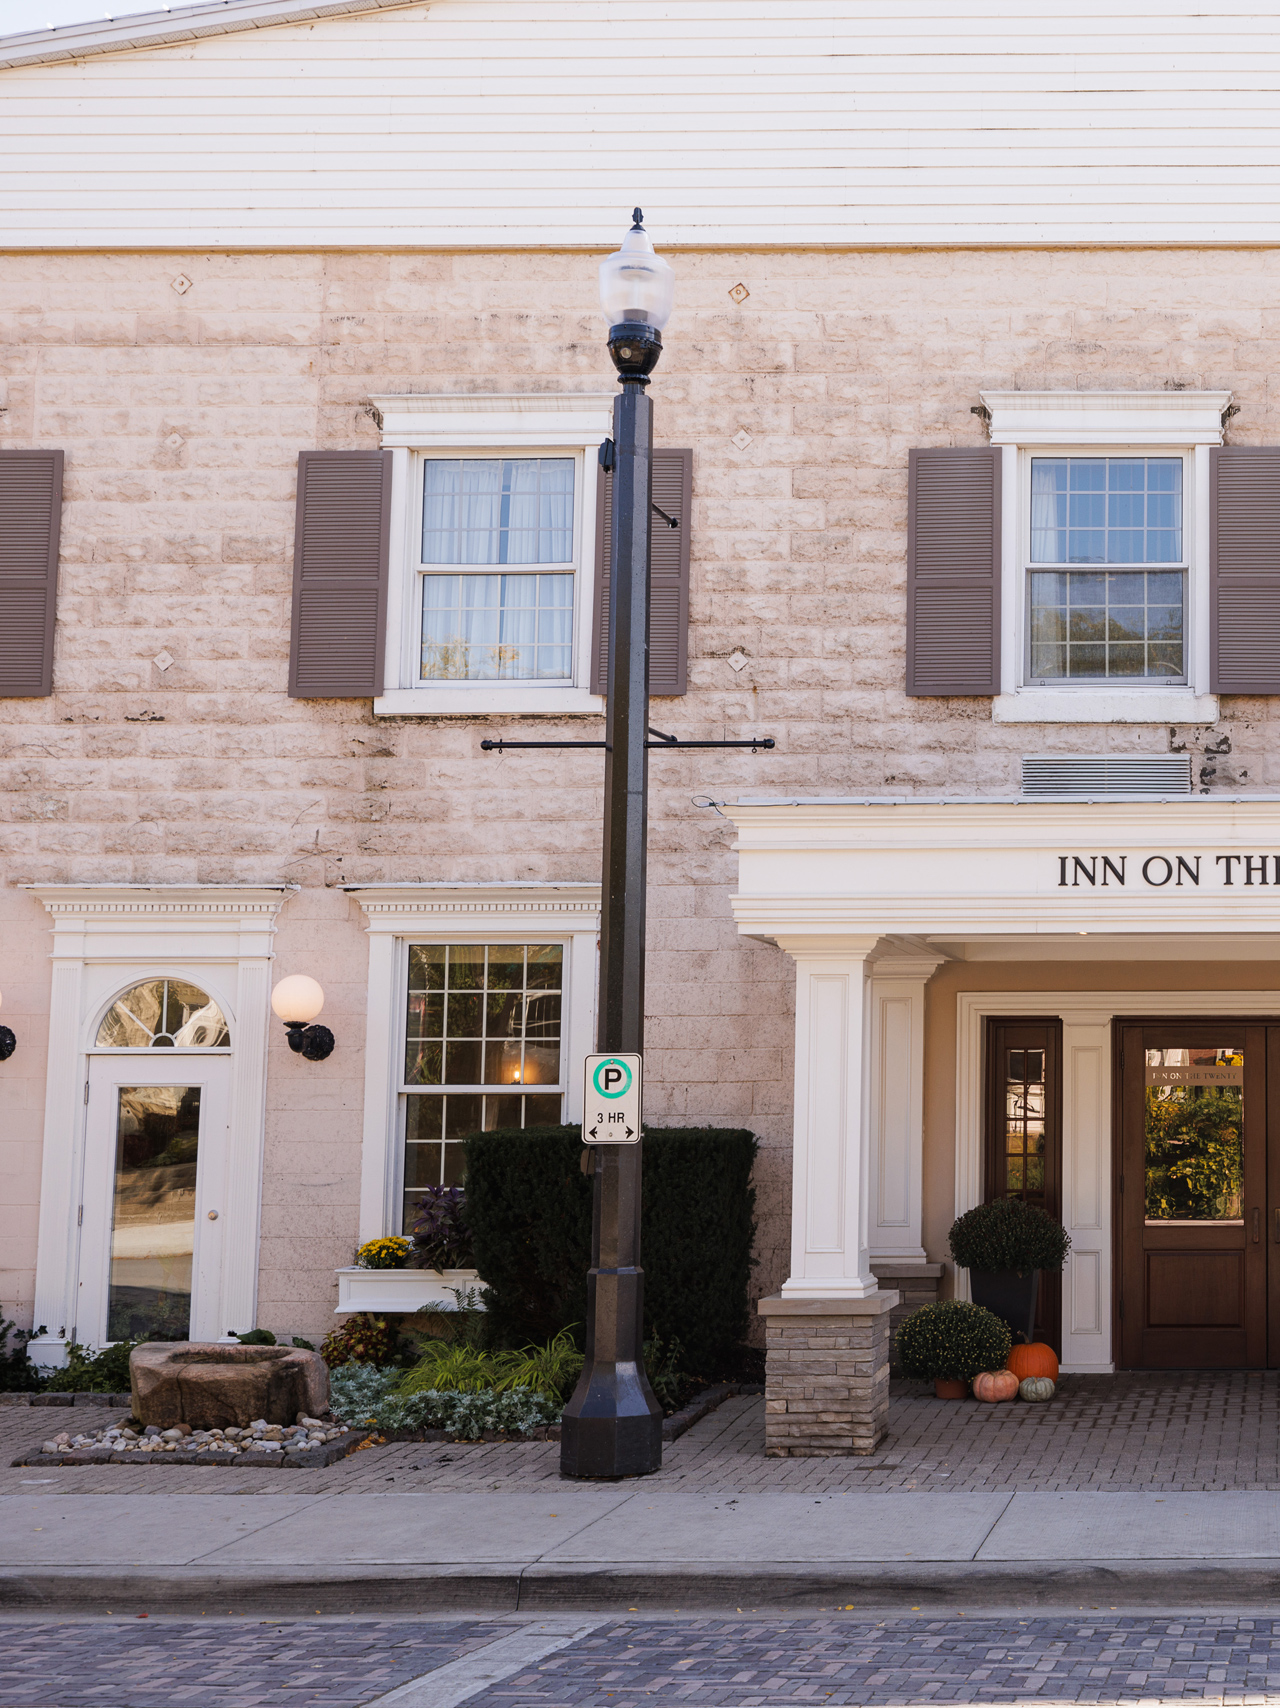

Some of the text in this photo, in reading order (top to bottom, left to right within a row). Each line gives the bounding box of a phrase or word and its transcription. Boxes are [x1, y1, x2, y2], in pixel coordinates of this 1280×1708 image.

[1058, 855, 1128, 887] INN
[1142, 855, 1201, 887] ON
[604, 1068, 622, 1090] P
[1169, 1072, 1182, 1080] ON
[1185, 1072, 1201, 1080] THE
[1203, 1072, 1238, 1080] TWENTY
[597, 1112, 625, 1124] 3 HR
